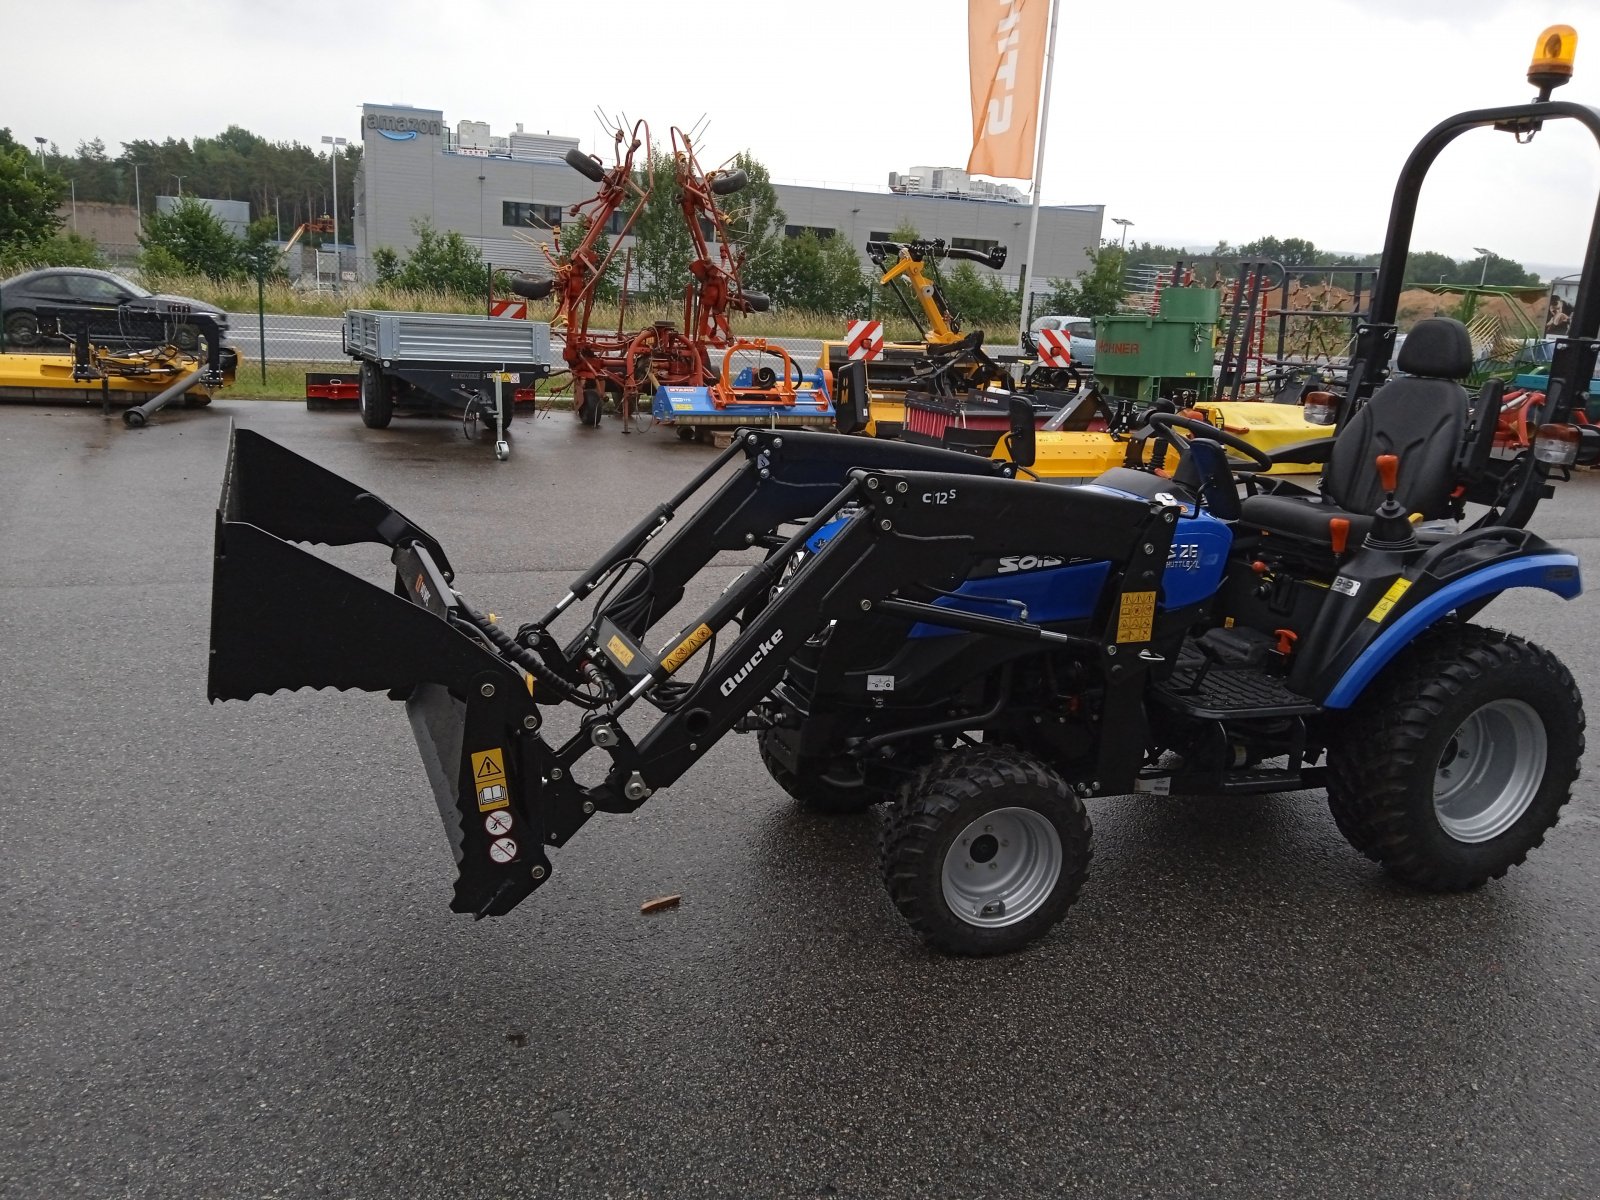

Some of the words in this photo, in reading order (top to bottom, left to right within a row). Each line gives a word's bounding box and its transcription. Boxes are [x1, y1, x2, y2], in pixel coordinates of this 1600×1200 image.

[367, 114, 440, 135] amazon
[1165, 560, 1190, 569] HUTTLE
[720, 628, 783, 696] Quicke
